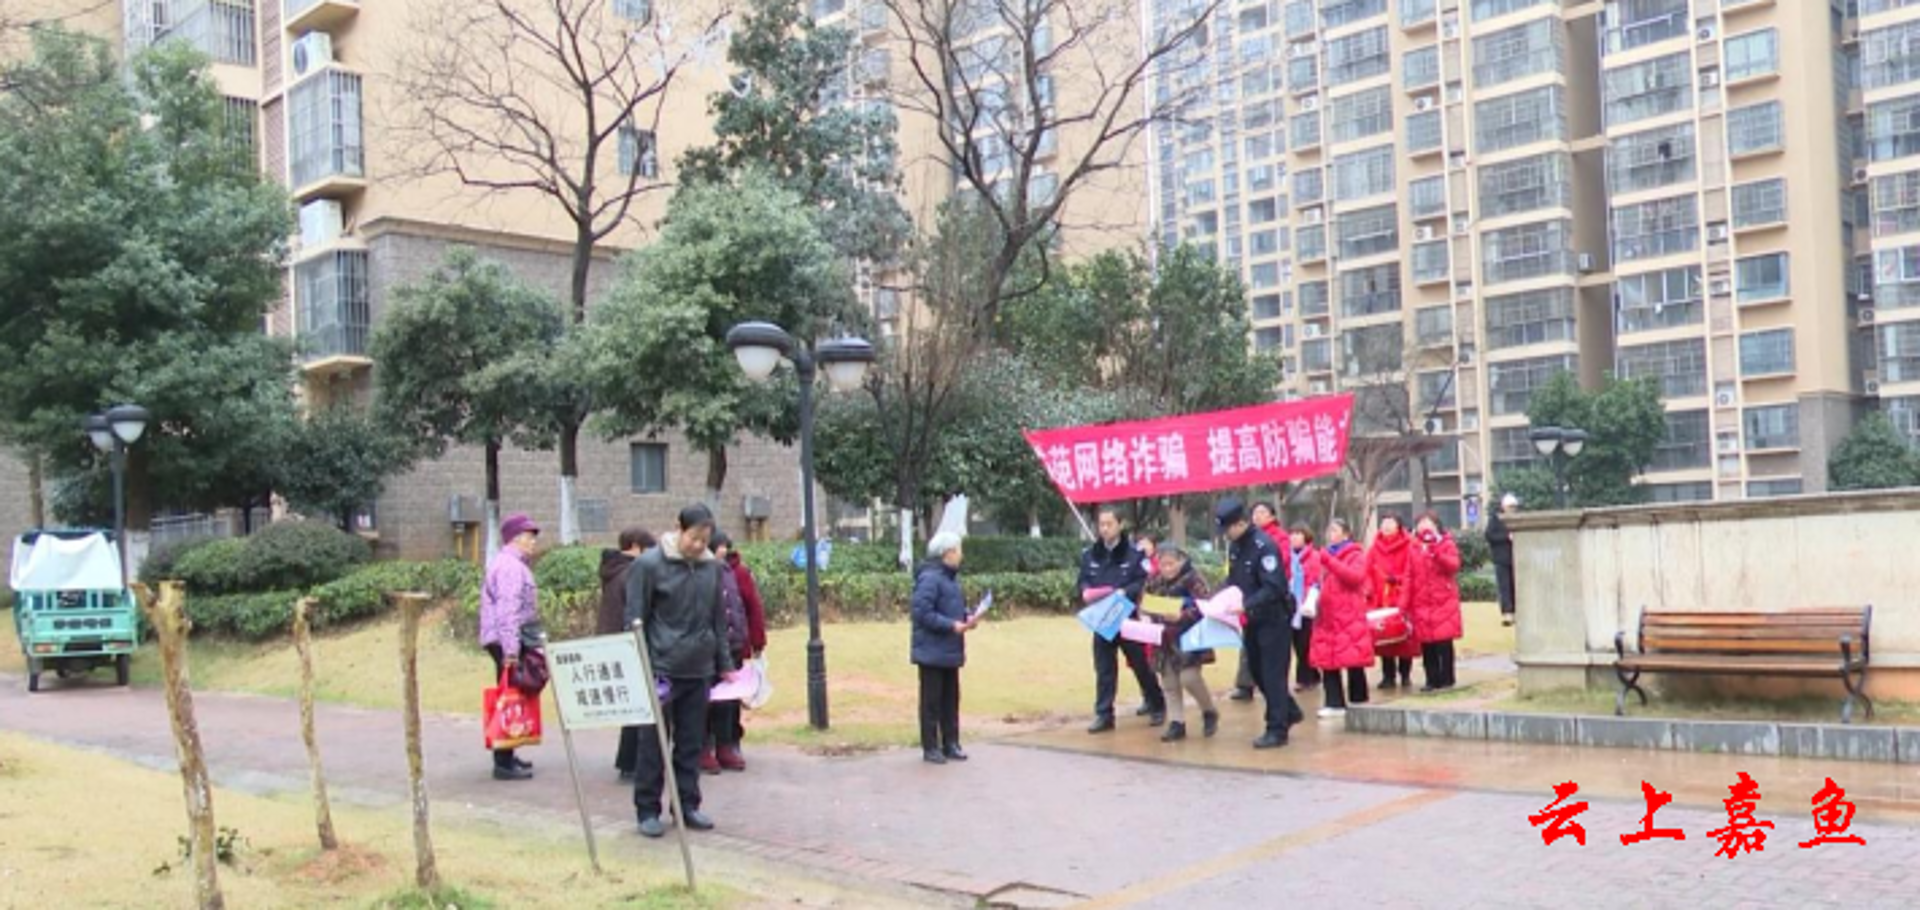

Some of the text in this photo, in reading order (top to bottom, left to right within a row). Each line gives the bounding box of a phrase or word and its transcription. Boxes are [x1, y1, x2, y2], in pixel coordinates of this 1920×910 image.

[571, 661, 625, 685] 人行通道
[575, 685, 630, 706] 减速慢行
